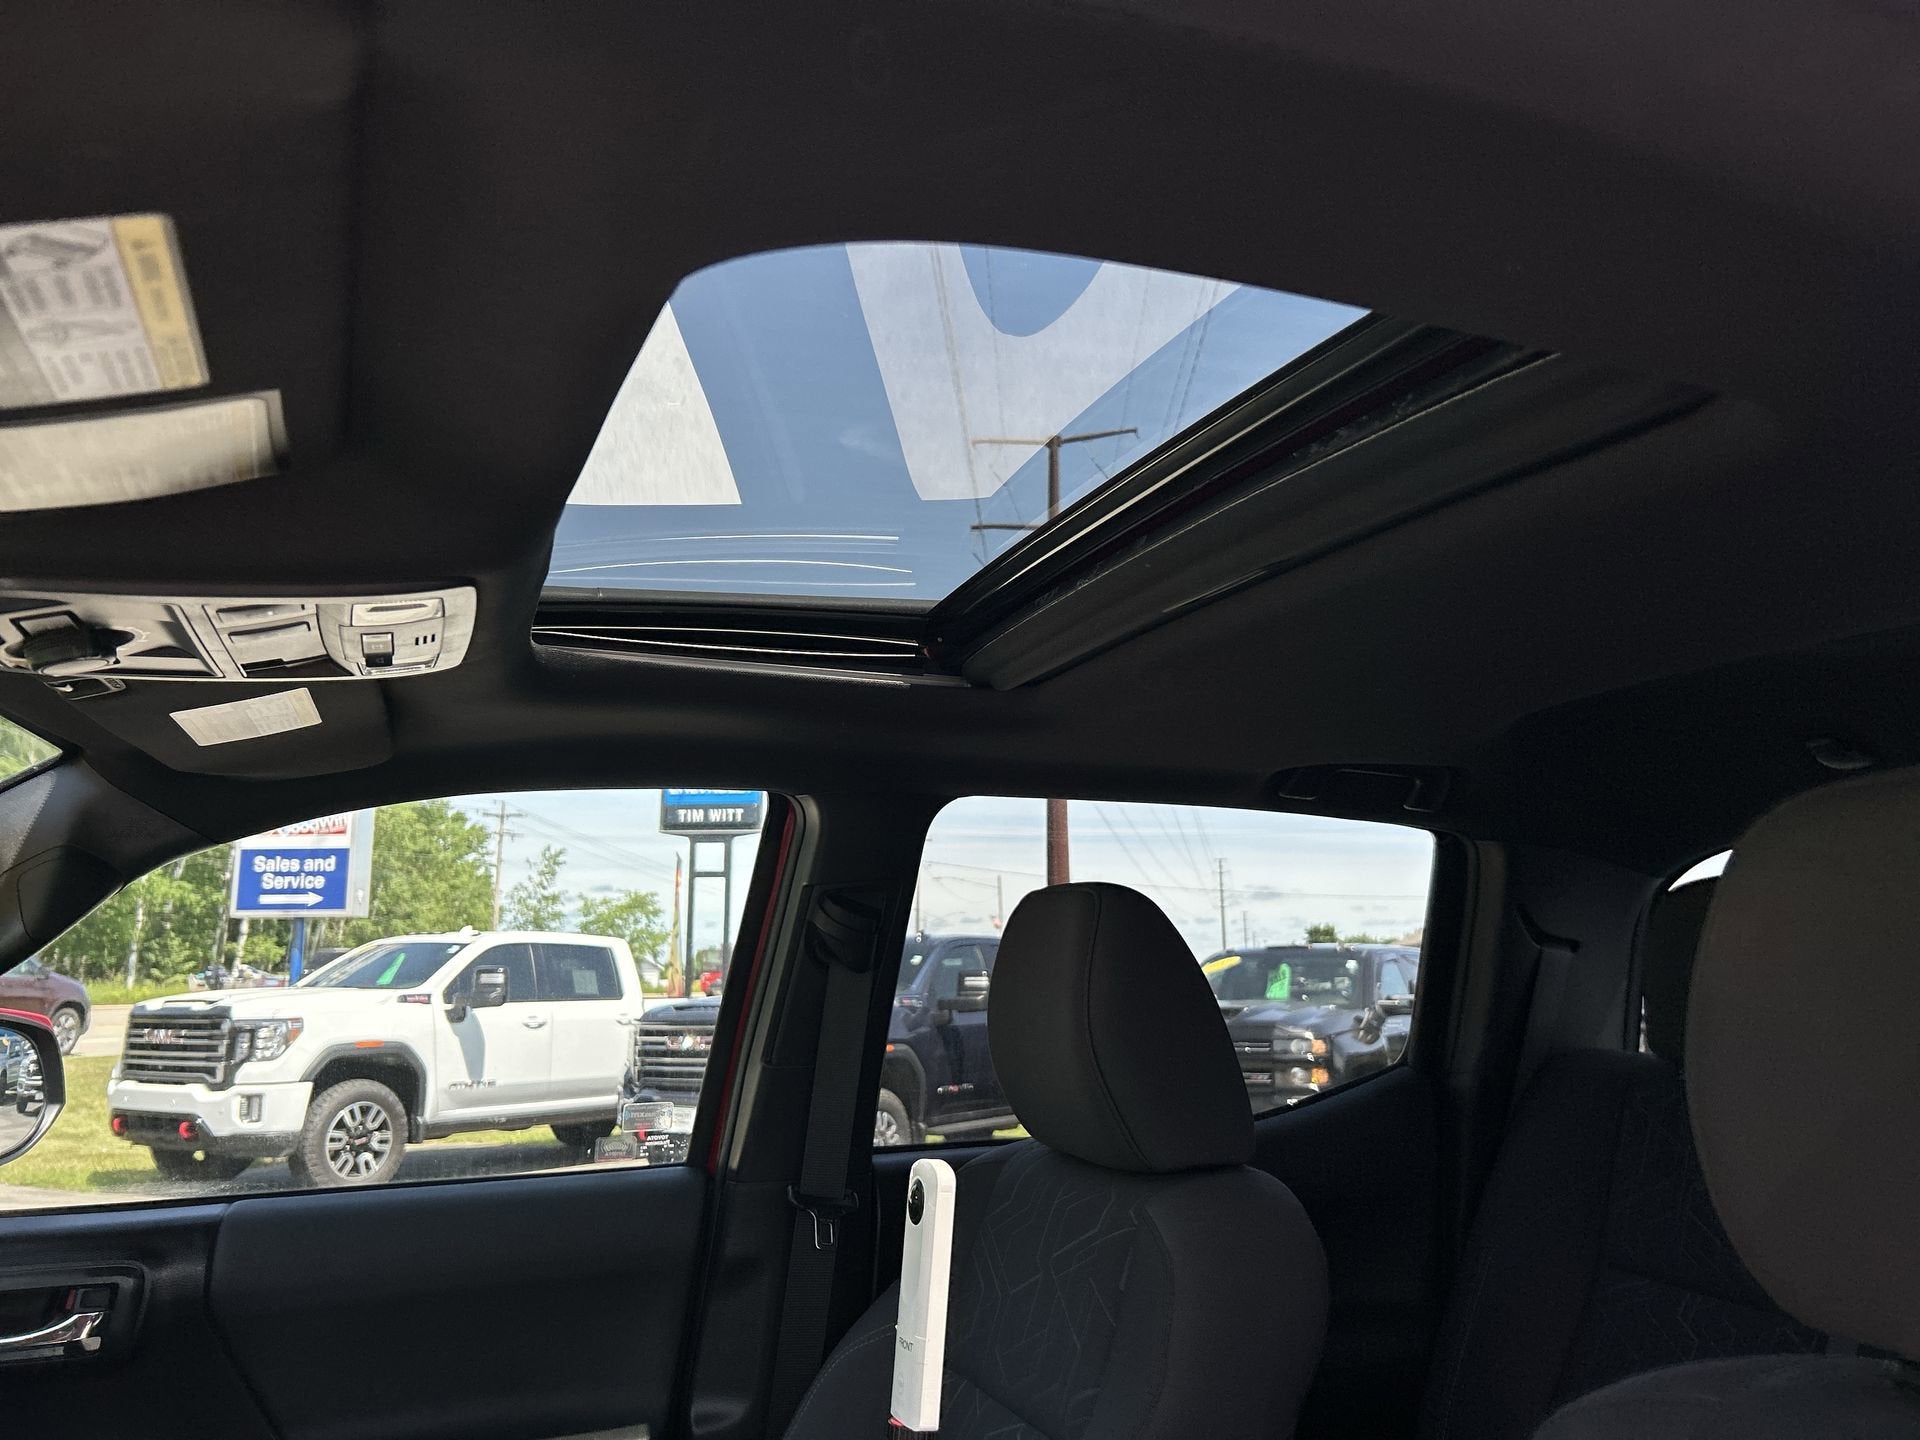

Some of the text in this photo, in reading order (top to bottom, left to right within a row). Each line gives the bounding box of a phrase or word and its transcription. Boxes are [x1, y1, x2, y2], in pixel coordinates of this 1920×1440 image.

[677, 808, 744, 822] TIM WITT
[253, 855, 336, 873] Sales and
[261, 873, 325, 889] Service
